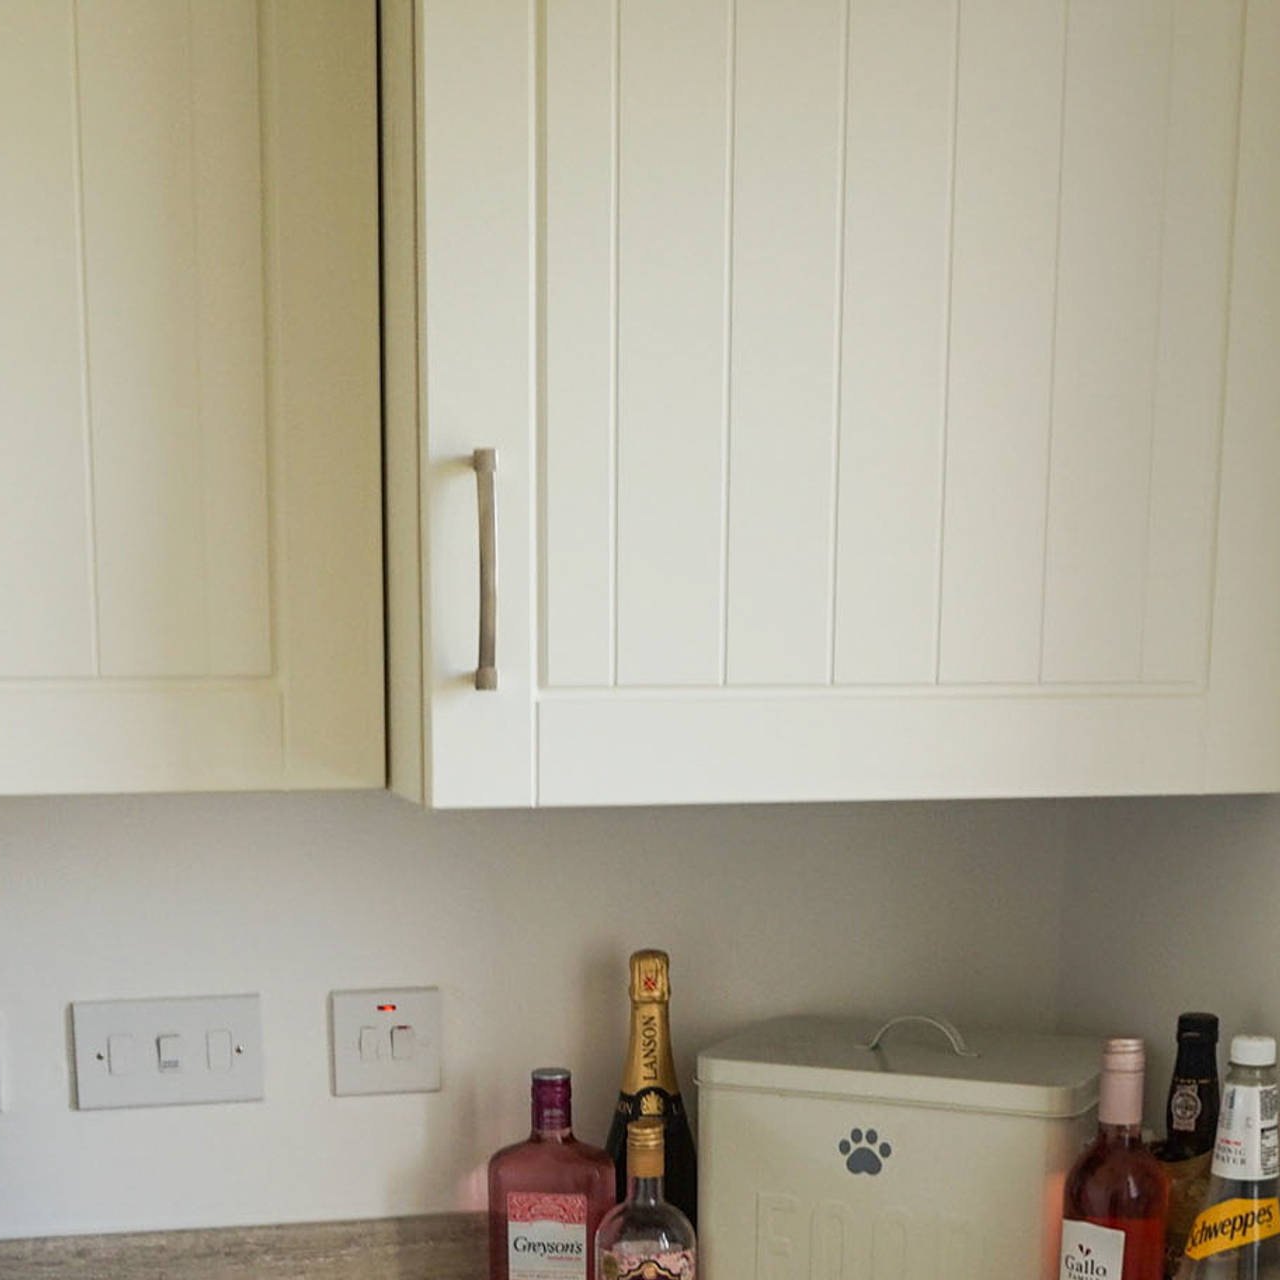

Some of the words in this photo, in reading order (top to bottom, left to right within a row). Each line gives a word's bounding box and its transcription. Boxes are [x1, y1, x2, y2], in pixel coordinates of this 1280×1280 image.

[642, 1015, 658, 1081] LANSON
[513, 1235, 583, 1257] Greyson's
[1065, 1255, 1107, 1277] Gallo
